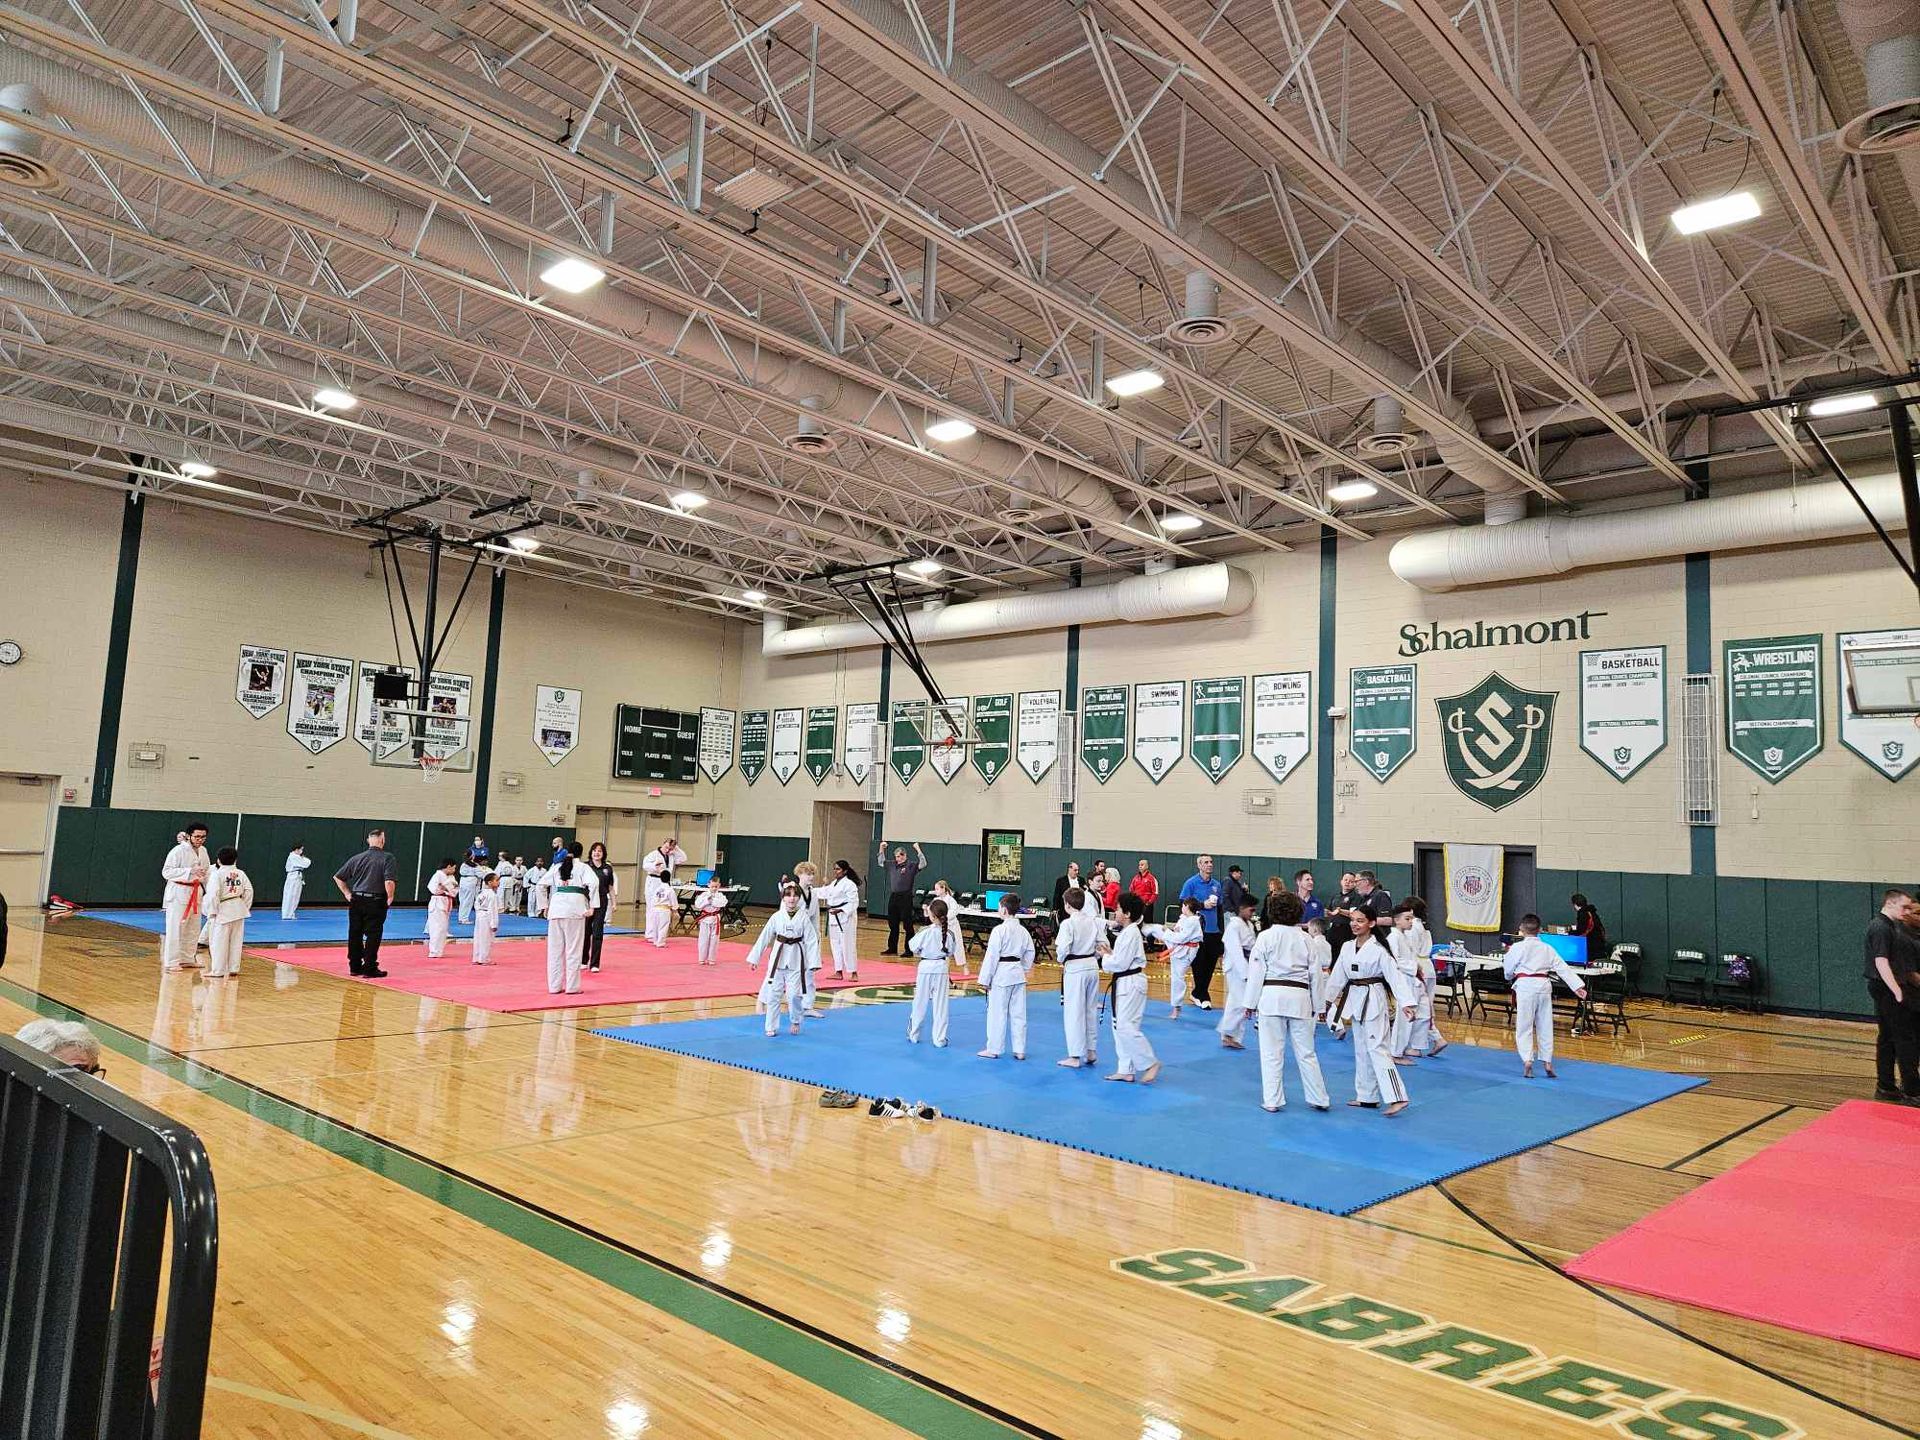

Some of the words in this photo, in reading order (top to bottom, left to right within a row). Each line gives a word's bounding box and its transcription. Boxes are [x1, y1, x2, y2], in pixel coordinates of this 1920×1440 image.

[1398, 610, 1608, 657] Schalmont
[1753, 650, 1815, 666] WRESTLING
[296, 659, 313, 669] NEW
[313, 661, 330, 670] YORK
[331, 663, 351, 676] STATE
[1601, 657, 1660, 670] BASKETBALL
[300, 668, 335, 678] CHAMPION
[1366, 673, 1412, 684] BASKETBALL
[452, 680, 470, 690] STATE
[1273, 681, 1302, 690] BOWLING
[1151, 689, 1179, 699] SWIMMING
[1029, 698, 1058, 706] VOLLEYBALL
[624, 725, 642, 734] HOME
[677, 731, 695, 740] GUEST
[1110, 1247, 1808, 1440] SABRES
